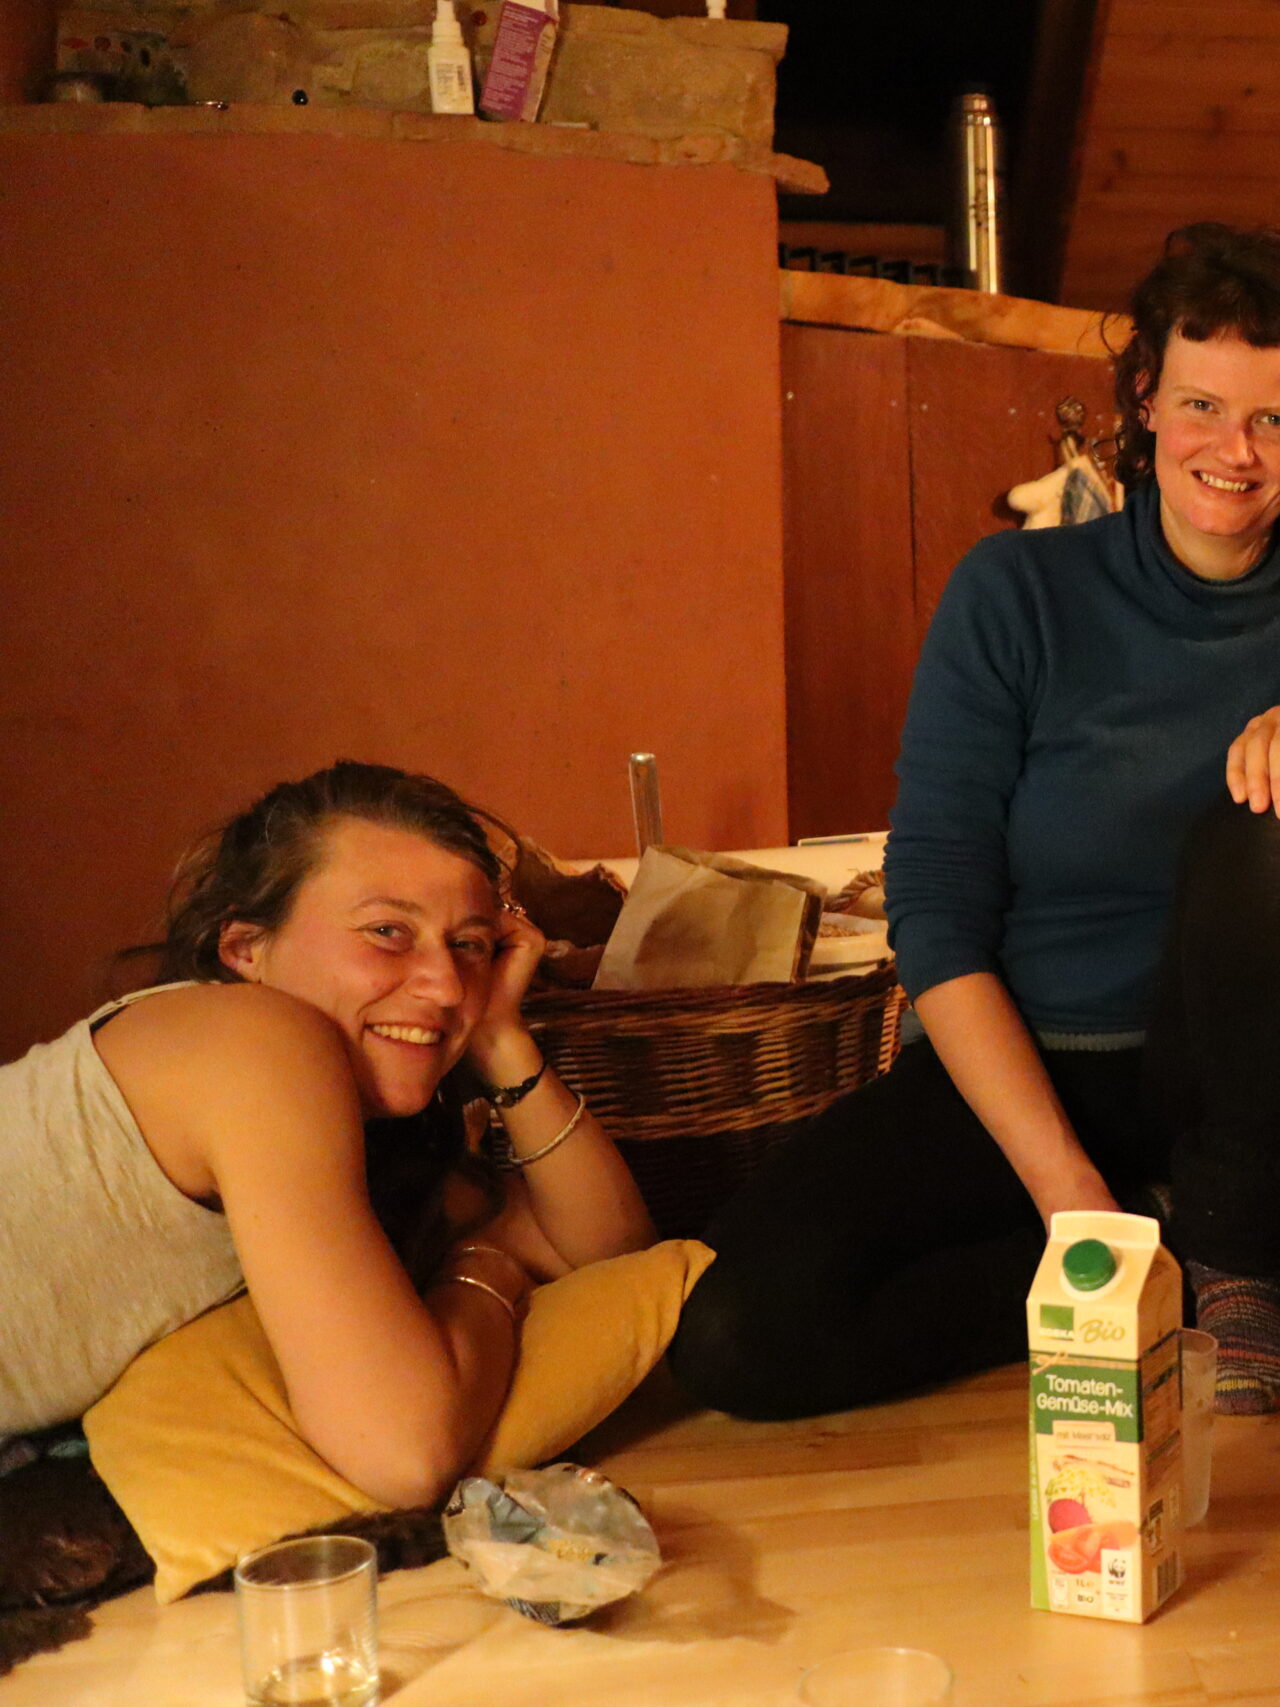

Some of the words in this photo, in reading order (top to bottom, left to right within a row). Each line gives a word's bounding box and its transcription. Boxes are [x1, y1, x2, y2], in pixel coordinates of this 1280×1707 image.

[1079, 1319, 1125, 1343] Bio
[1045, 1374, 1124, 1398] Tomaten-
[1036, 1392, 1134, 1418] Gemüse-Mix
